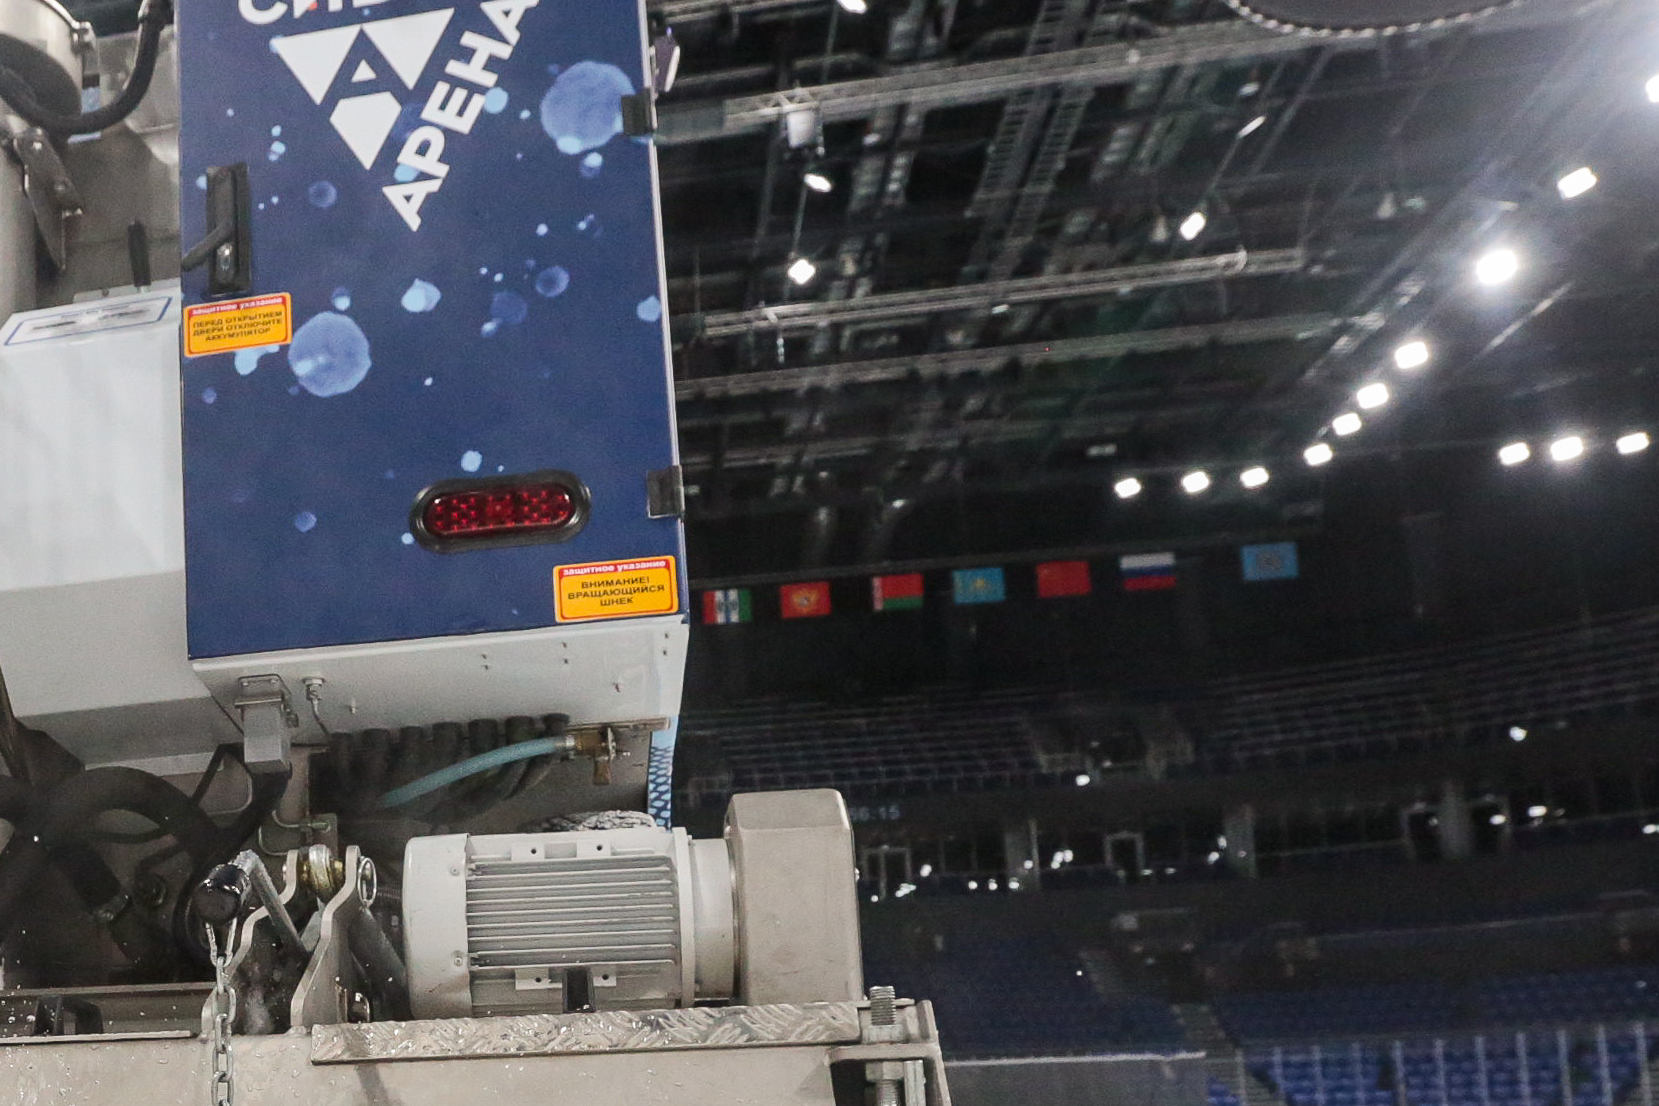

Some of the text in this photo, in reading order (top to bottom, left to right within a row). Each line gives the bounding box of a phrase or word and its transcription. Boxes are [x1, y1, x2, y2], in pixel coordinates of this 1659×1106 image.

[382, 0, 539, 232] АРЕНА
[193, 311, 282, 329] ПЕРЕД ОТКРЫТИЕМ
[193, 319, 282, 337] ДВЕРИ ОТКЛЮЧИТЕ
[205, 327, 271, 341] АККУМУЛЯТОР
[563, 560, 666, 576] защитное указание
[581, 576, 650, 589] ВНИМАНИЕ!
[567, 584, 665, 600] ВРАЩАЮЩИЙСЯ
[599, 597, 634, 607] ШНЕК
